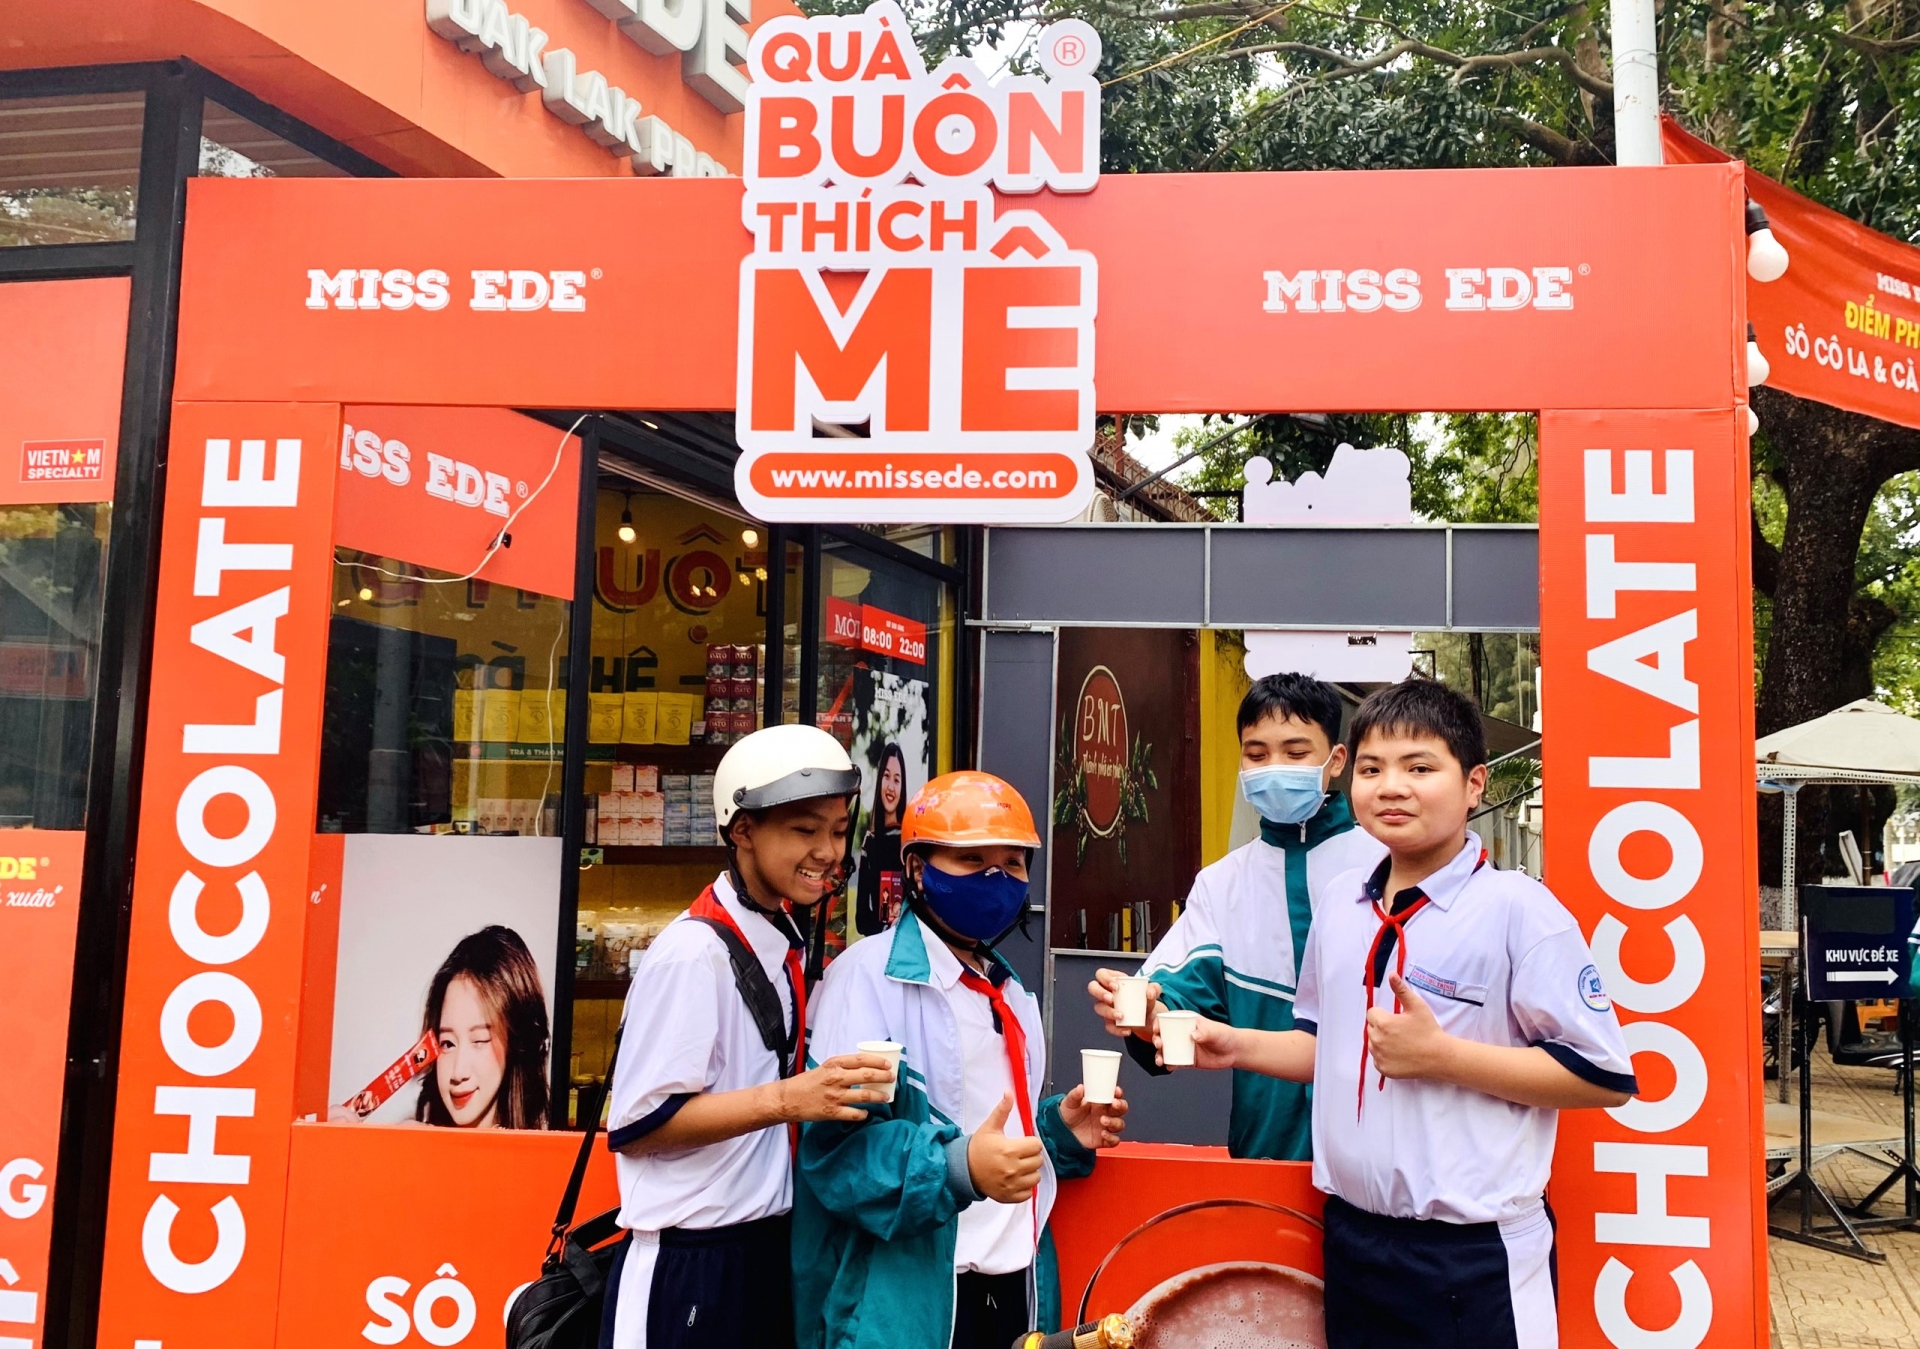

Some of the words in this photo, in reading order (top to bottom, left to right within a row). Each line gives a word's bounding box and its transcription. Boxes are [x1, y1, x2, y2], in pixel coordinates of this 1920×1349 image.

[761, 16, 911, 82] QUÀ
[556, 48, 642, 154] LAK
[757, 73, 1084, 178] BUÔN
[756, 187, 977, 253] THÍCH
[305, 269, 449, 310] MISS
[469, 270, 586, 311] EDE
[1262, 268, 1422, 312] MISS
[1445, 266, 1573, 310] EDE
[1876, 272, 1911, 299] MISS
[750, 226, 1082, 431] MÊ
[1845, 293, 1891, 341] ĐIỂM
[1895, 317, 1920, 349] PH
[1785, 322, 1810, 360] SÔ
[1814, 334, 1843, 370] CÔ
[1847, 347, 1870, 379] LA
[1874, 355, 1887, 384] &
[1891, 357, 1920, 393] CÀ
[27, 465, 100, 480] SPECIALTY
[425, 452, 510, 519] EDE
[770, 465, 1057, 490] www.missede.com
[863, 626, 892, 651] 08:00
[899, 636, 925, 660] 22:00
[142, 437, 301, 1295] CHOCOLATE
[1584, 449, 1713, 1349] CHOCOLATE
[1825, 949, 1848, 963] KHU
[1848, 947, 1870, 966] VỰC
[1870, 945, 1885, 963] ĐỂ
[1886, 949, 1899, 963] XE
[361, 1262, 477, 1347] SÔ
